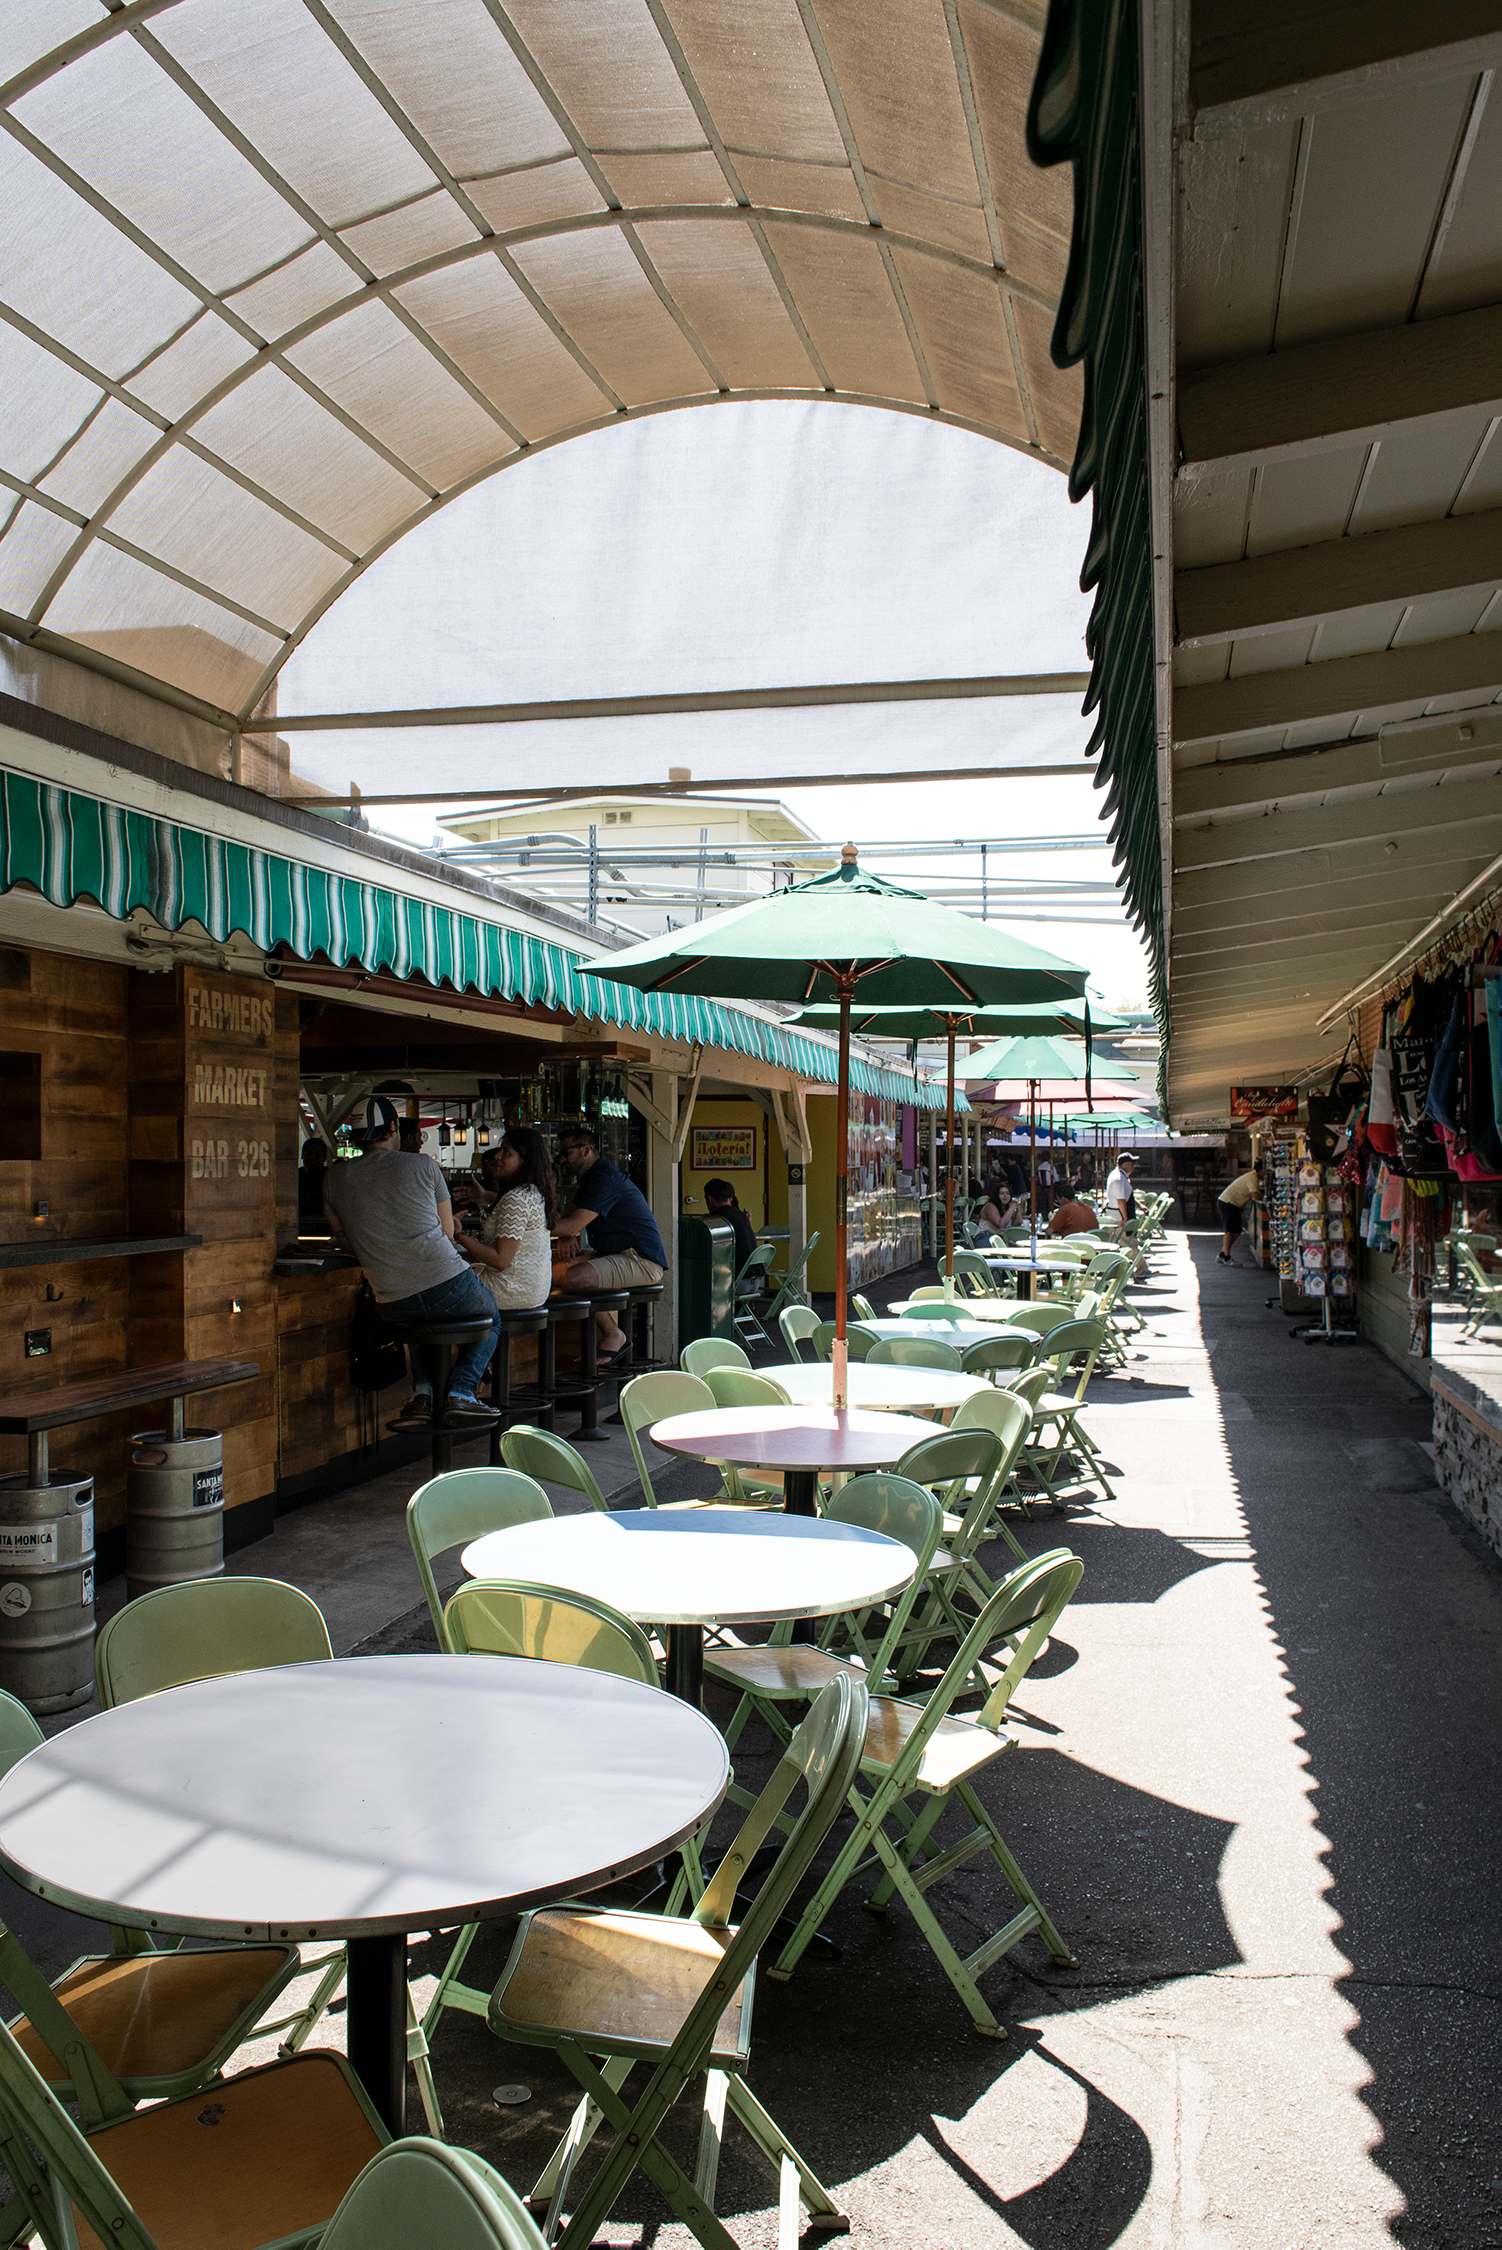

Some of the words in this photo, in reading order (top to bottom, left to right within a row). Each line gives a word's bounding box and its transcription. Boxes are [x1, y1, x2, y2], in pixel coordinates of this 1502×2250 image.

[189, 987, 273, 1036] FARMERS
[194, 1064, 267, 1106] MARKET
[1234, 1096, 1294, 1114] Candlelight
[192, 1140, 229, 1178] BAR
[238, 1140, 270, 1177] 326
[698, 1142, 749, 1155] ¡Lotería!
[14, 1533, 53, 1546] MONICA
